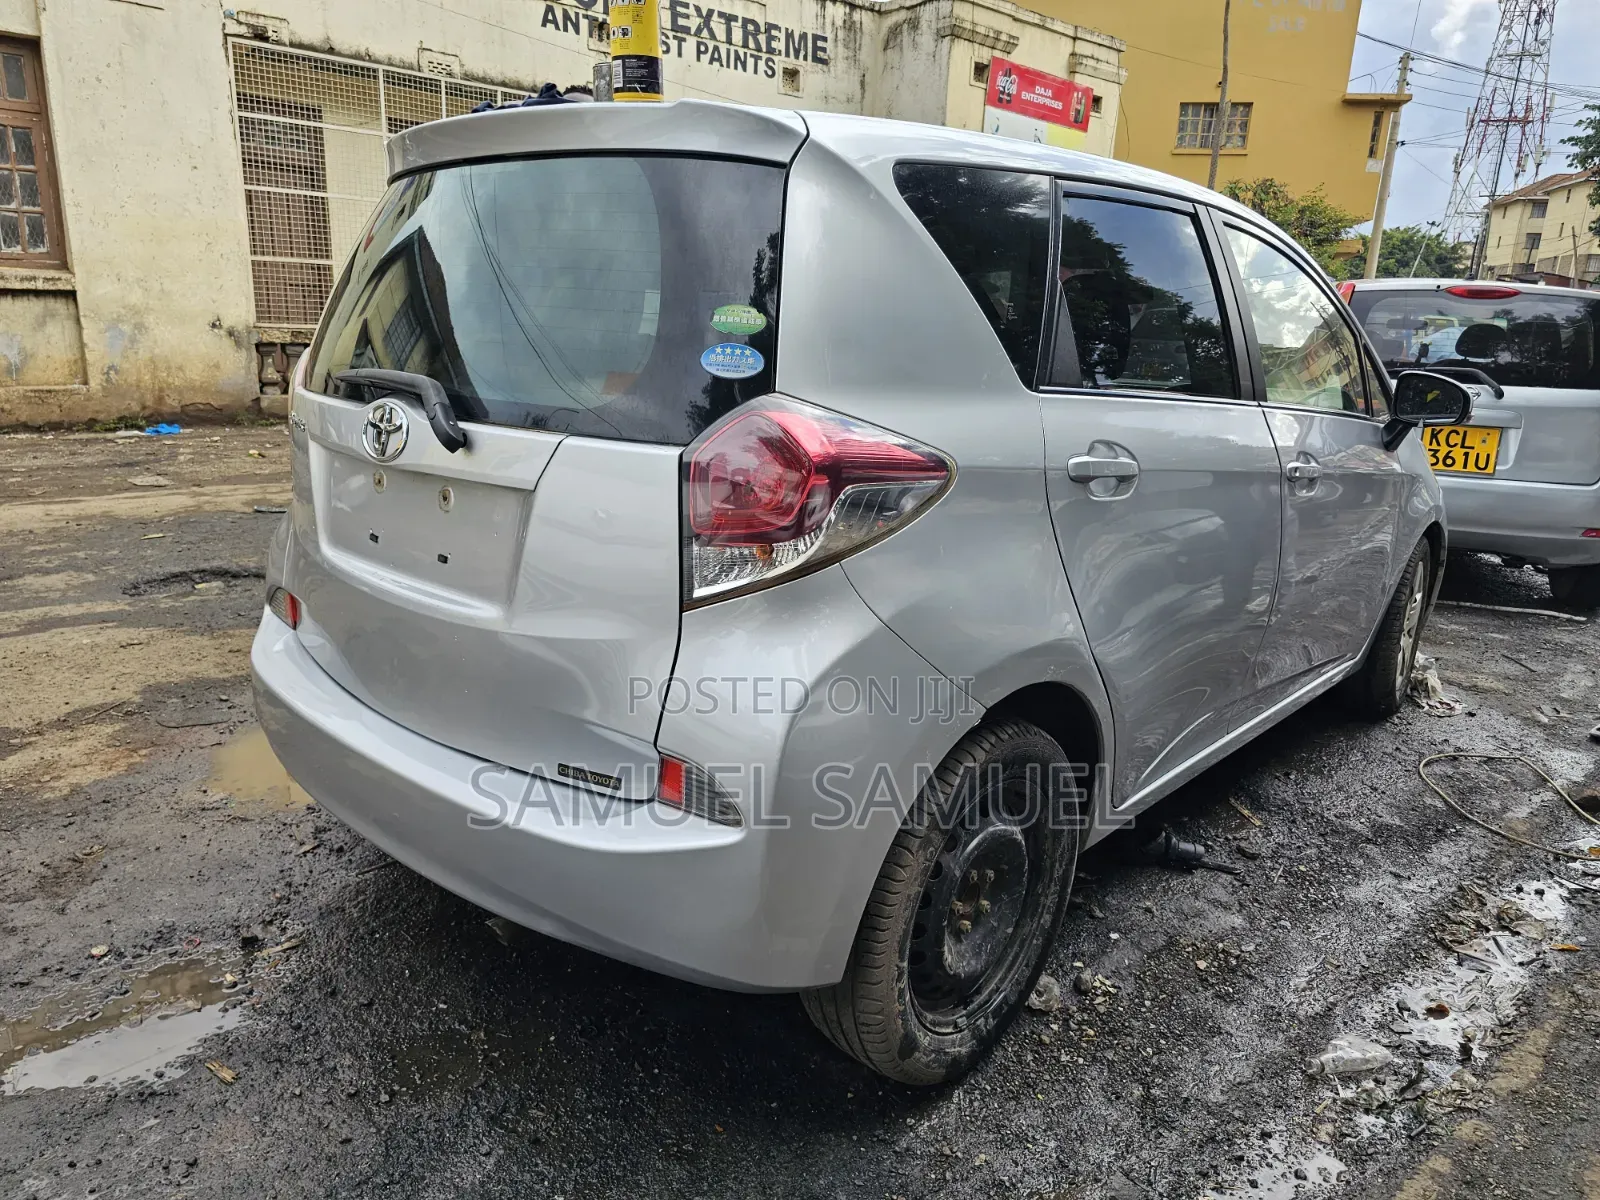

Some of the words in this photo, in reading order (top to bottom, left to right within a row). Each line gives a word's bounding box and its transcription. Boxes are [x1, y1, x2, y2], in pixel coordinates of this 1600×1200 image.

[540, 3, 609, 43] ANT
[696, 40, 776, 79] PAINTS
[670, 0, 829, 66] EXTREME
[1021, 91, 1063, 110] ENTERPRISES
[1035, 85, 1052, 97] DAJA
[1429, 428, 1475, 450] KCL
[1428, 448, 1490, 470] 361U
[559, 766, 585, 779] CHIBA
[587, 773, 620, 788] TOYOTA
